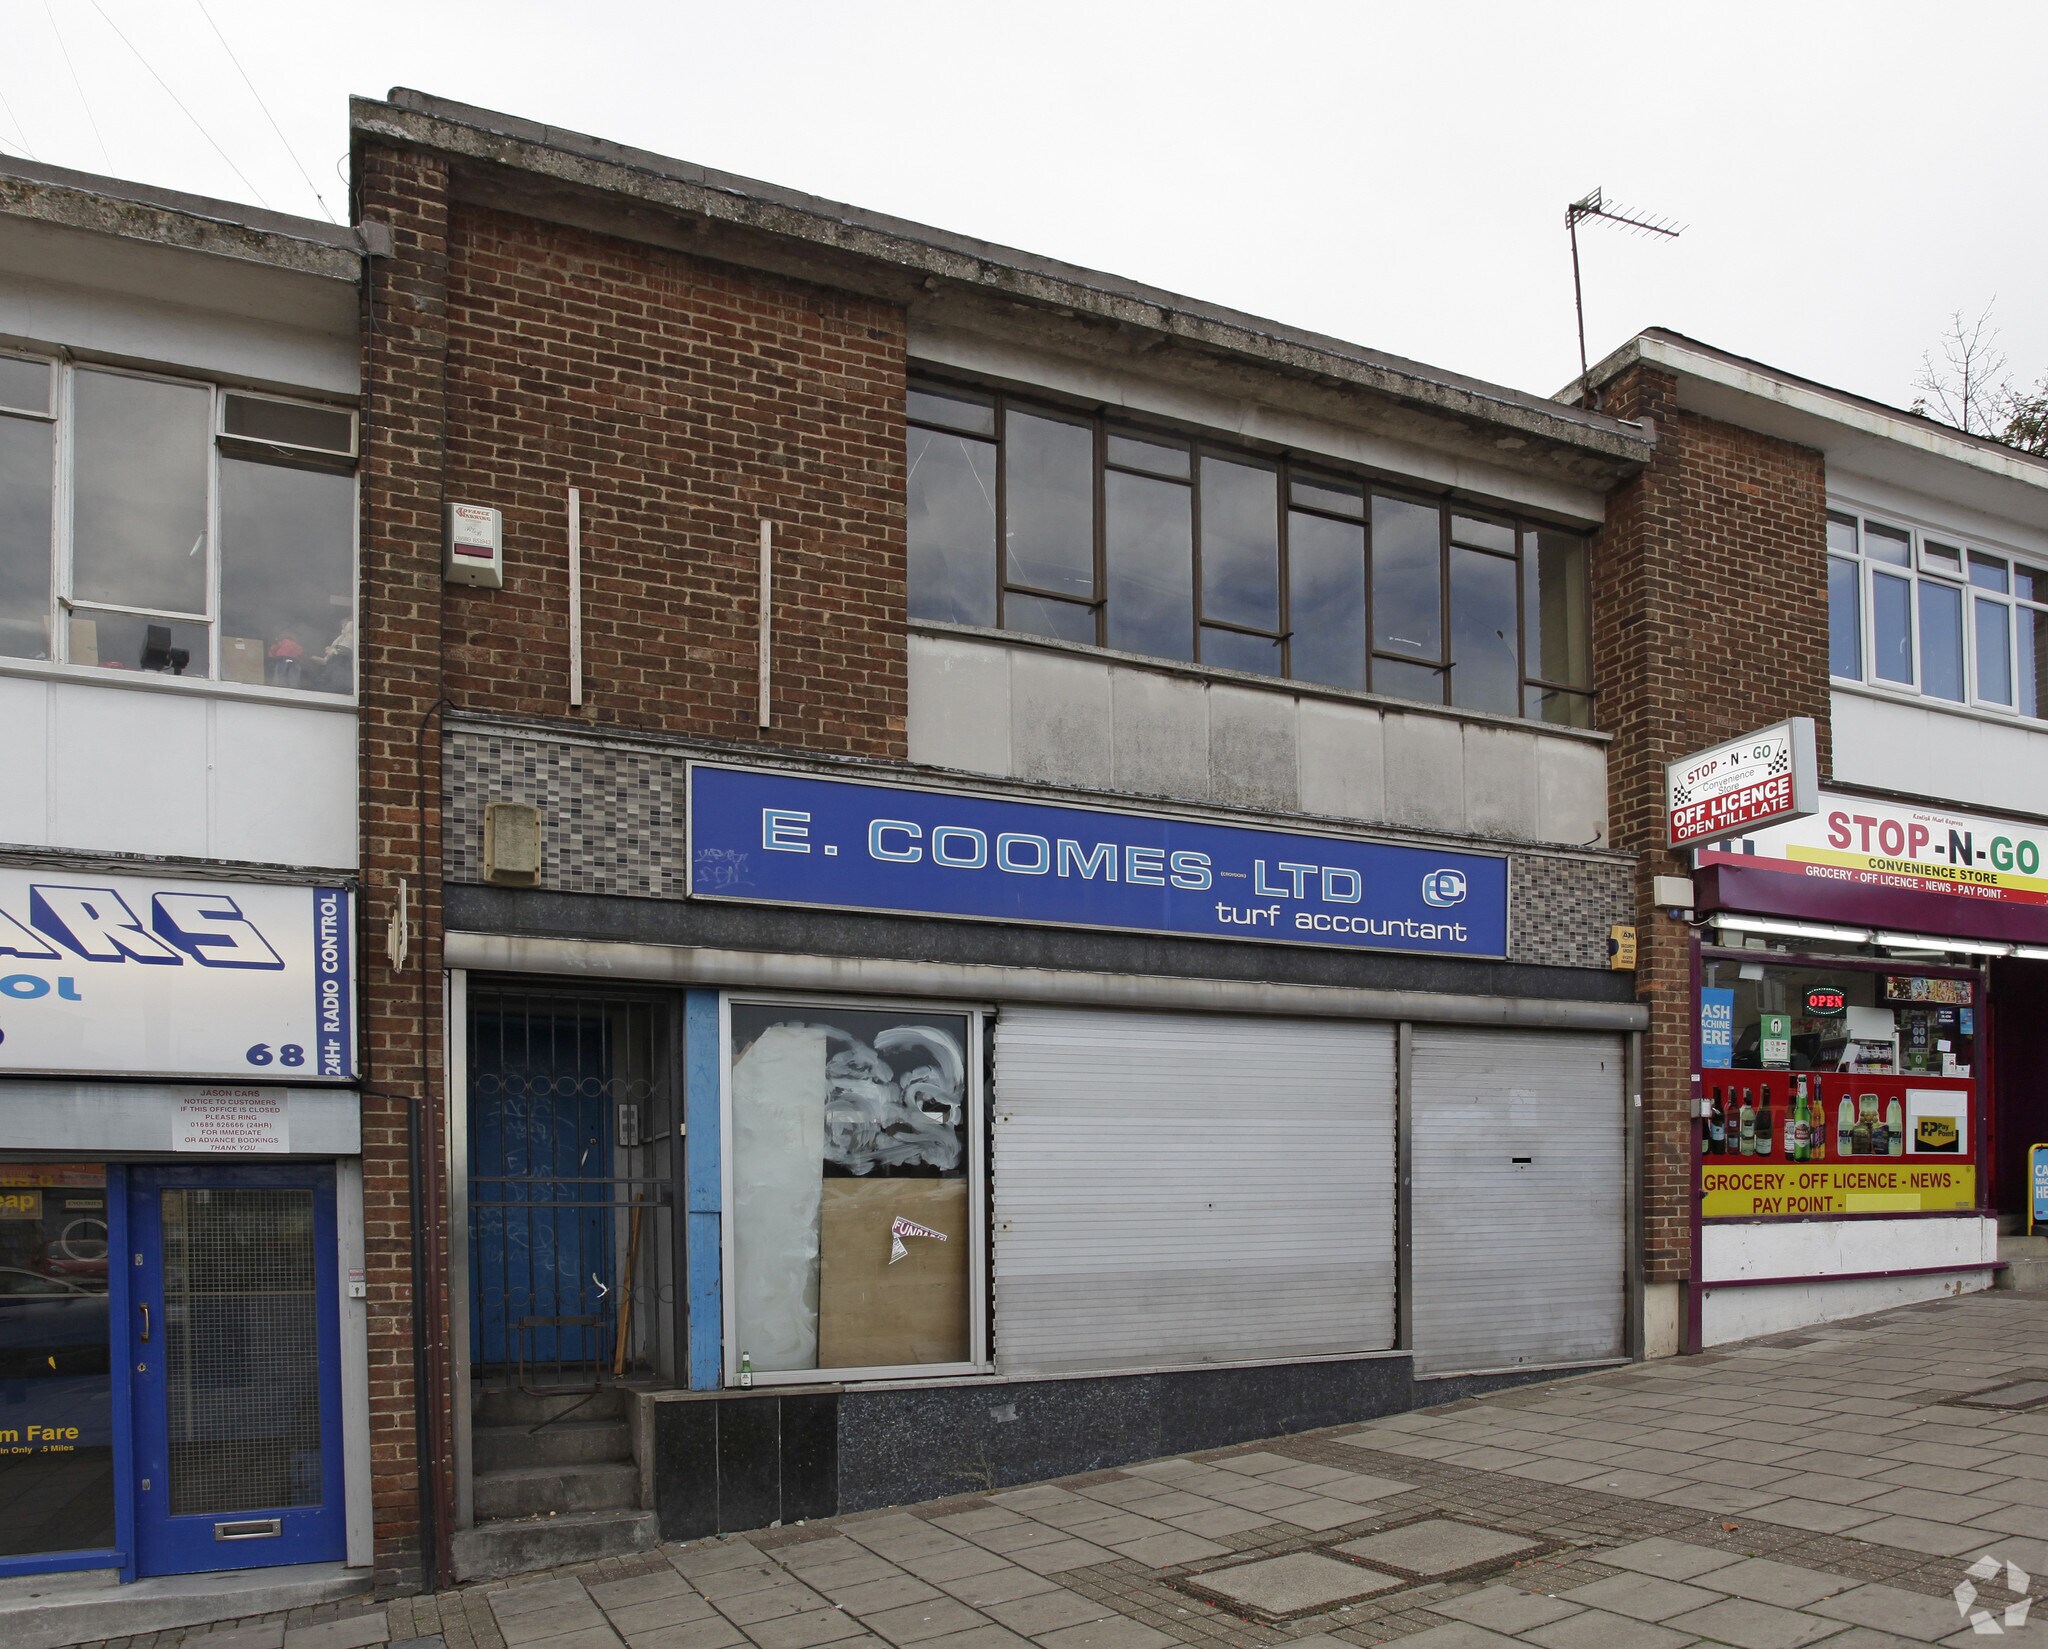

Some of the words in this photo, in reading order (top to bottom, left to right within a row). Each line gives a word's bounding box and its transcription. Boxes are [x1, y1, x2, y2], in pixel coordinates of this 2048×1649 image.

[1687, 760, 1718, 784] STOP
[1730, 752, 1739, 766] N
[1753, 744, 1771, 760] GO
[1703, 769, 1754, 791] Convenience
[1718, 782, 1740, 795] Store
[1673, 804, 1705, 826] OFF
[1711, 777, 1789, 816] LICENCE
[1677, 818, 1714, 838] OPEN
[1718, 810, 1747, 826] TILL
[1752, 796, 1788, 817] LATE
[763, 808, 838, 856] E.
[868, 818, 1212, 890] COOMES
[1254, 859, 1362, 904] LTD
[1806, 866, 1852, 880] GROCERY
[1860, 873, 1878, 883] OFF
[1880, 875, 1918, 889] LICENCE
[1926, 881, 1951, 893] NEWS
[1958, 884, 1975, 896] PAY
[1977, 887, 2001, 898] POINT
[1869, 858, 1956, 879] CONVENIENCE
[1960, 870, 1997, 884] STORE
[321, 893, 338, 974] CONTROL
[1215, 902, 1280, 926] turf
[1295, 911, 1467, 942] accountant
[323, 980, 339, 1032] RADIO
[1809, 995, 1843, 1007] OPEN
[246, 1043, 304, 1066] 68
[325, 1040, 341, 1075] 24Hr
[1938, 1123, 1949, 1131] Pay
[1704, 1174, 1785, 1191] GROCERY
[1799, 1173, 1828, 1189] OFF
[1834, 1173, 1897, 1189] LICENCE
[1910, 1173, 1951, 1188] NEWS
[1753, 1197, 1782, 1213] PAY
[1787, 1196, 1833, 1212] POINT
[27, 1425, 79, 1441] Fare
[12, 1446, 32, 1454] Only
